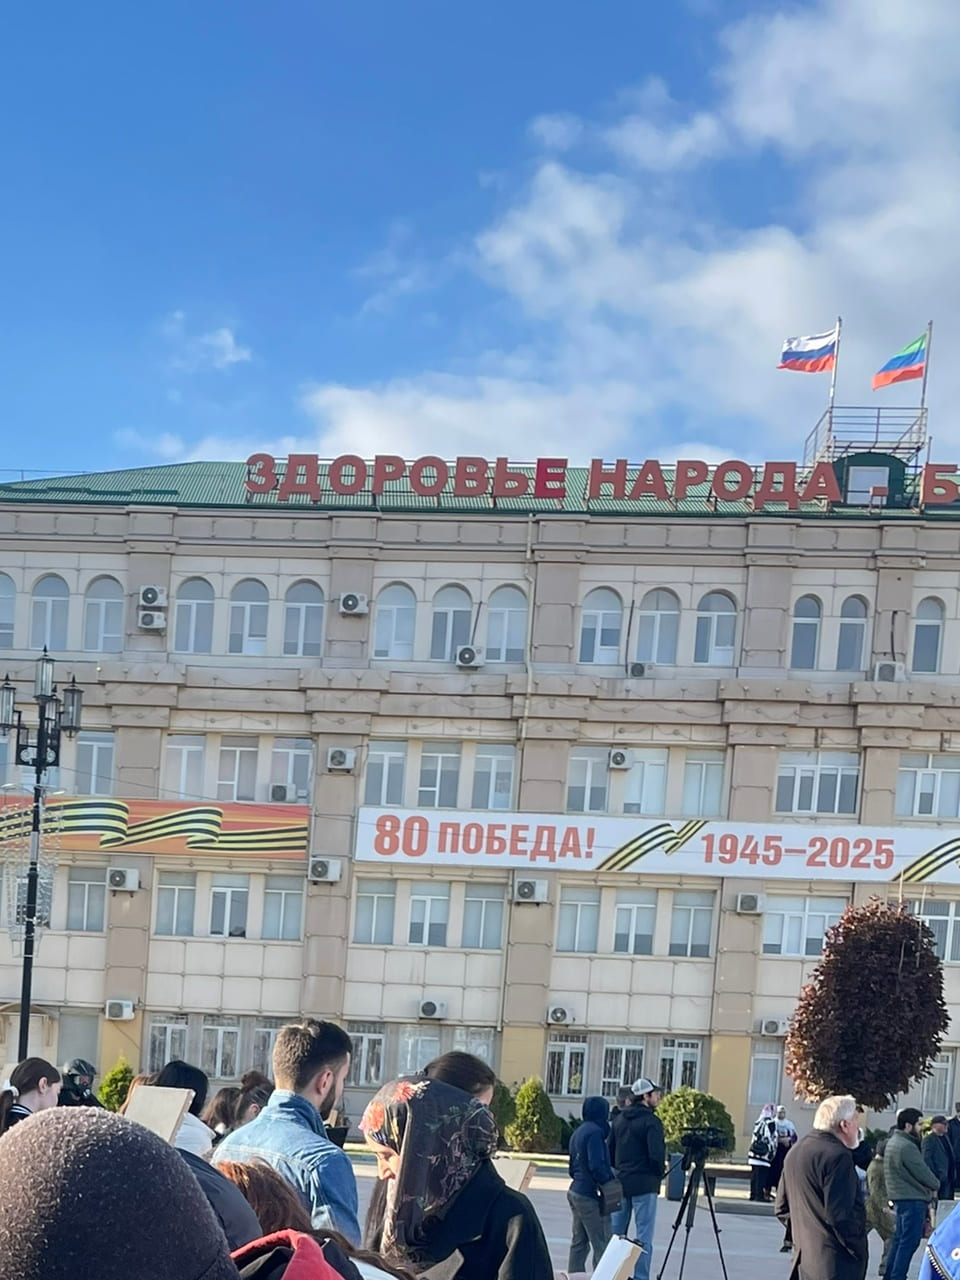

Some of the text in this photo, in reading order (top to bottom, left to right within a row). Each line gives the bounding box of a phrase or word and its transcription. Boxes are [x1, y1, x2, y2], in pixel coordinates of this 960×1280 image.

[246, 454, 568, 500] ЗДОРОВЬЕ
[589, 460, 841, 510] НАРОДА
[374, 814, 596, 862] 80 ПОБЕДА!
